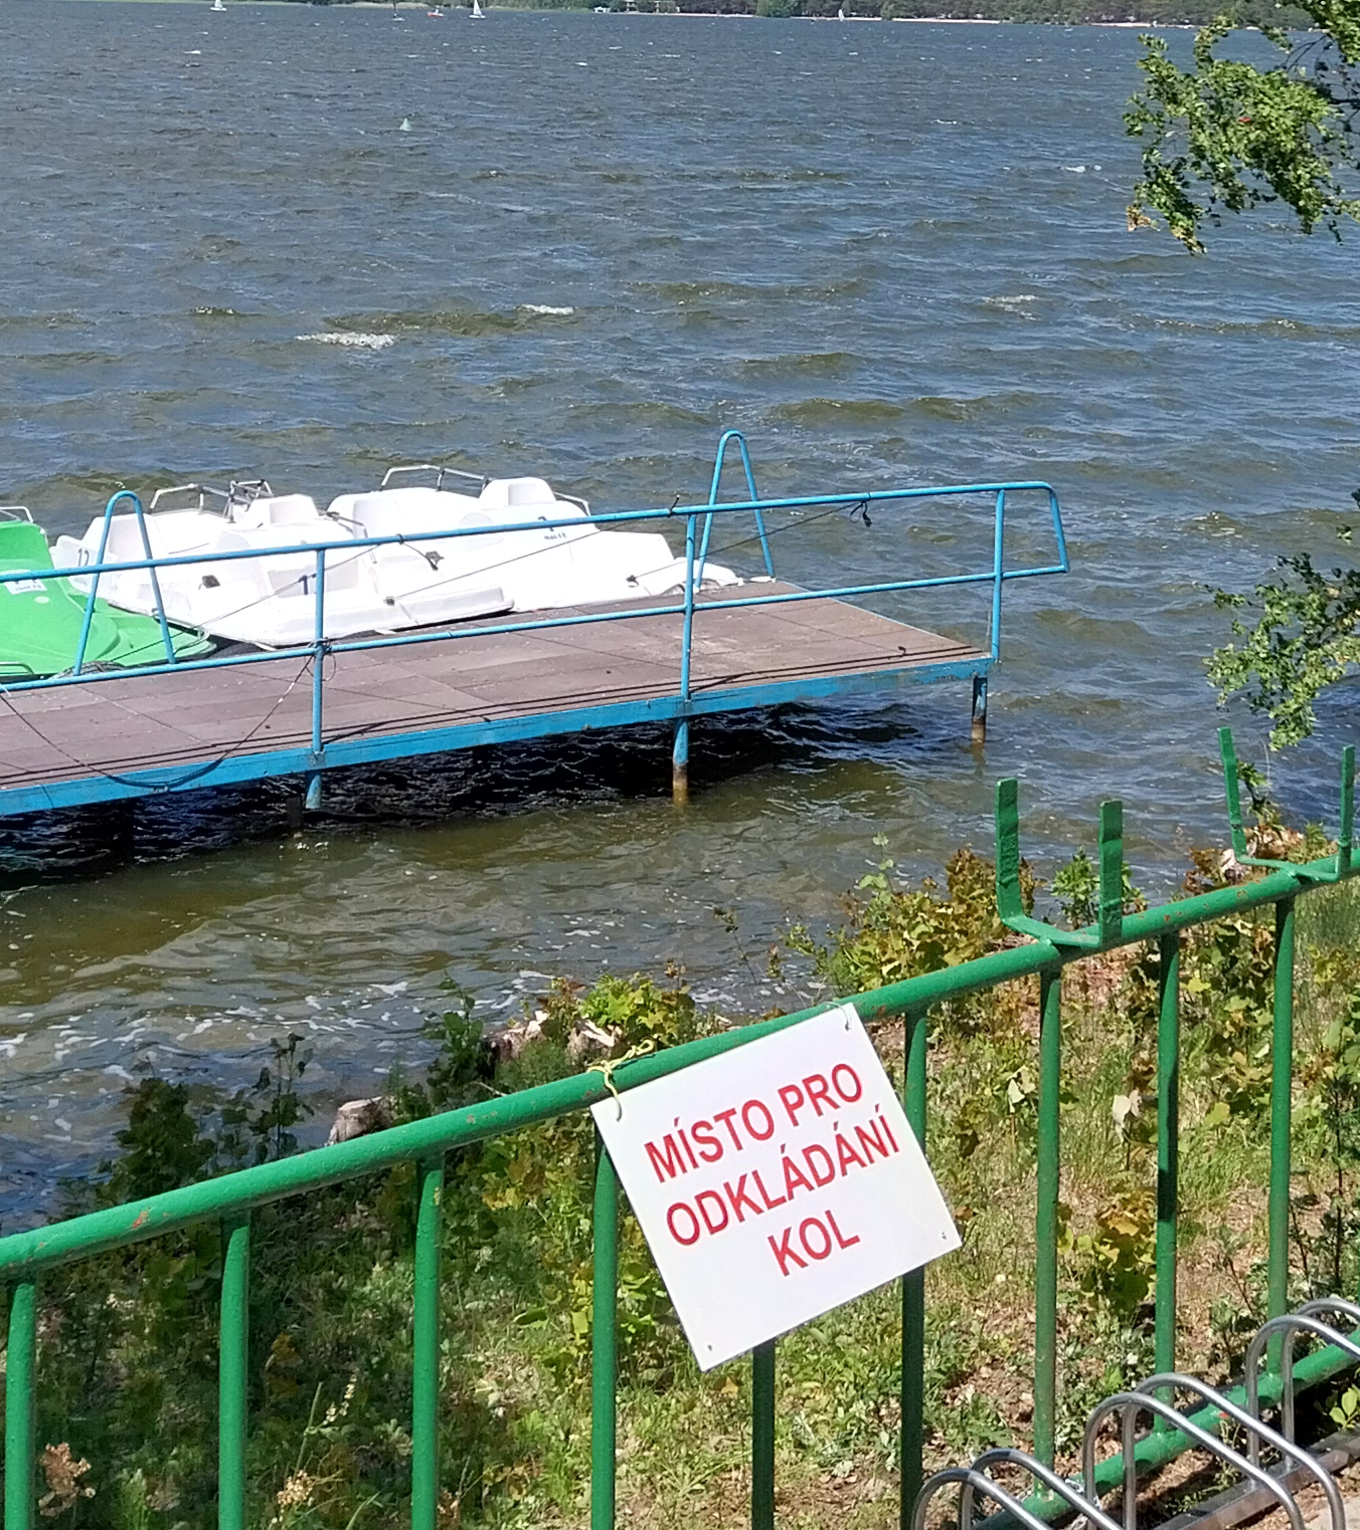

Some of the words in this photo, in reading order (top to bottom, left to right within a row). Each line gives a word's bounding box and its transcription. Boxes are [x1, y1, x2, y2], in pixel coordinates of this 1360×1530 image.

[644, 1099, 775, 1182] MÍSTO
[777, 1063, 863, 1126] PRO
[666, 1104, 900, 1246] ODKLÁDÁNÍ
[768, 1210, 860, 1276] KOL
